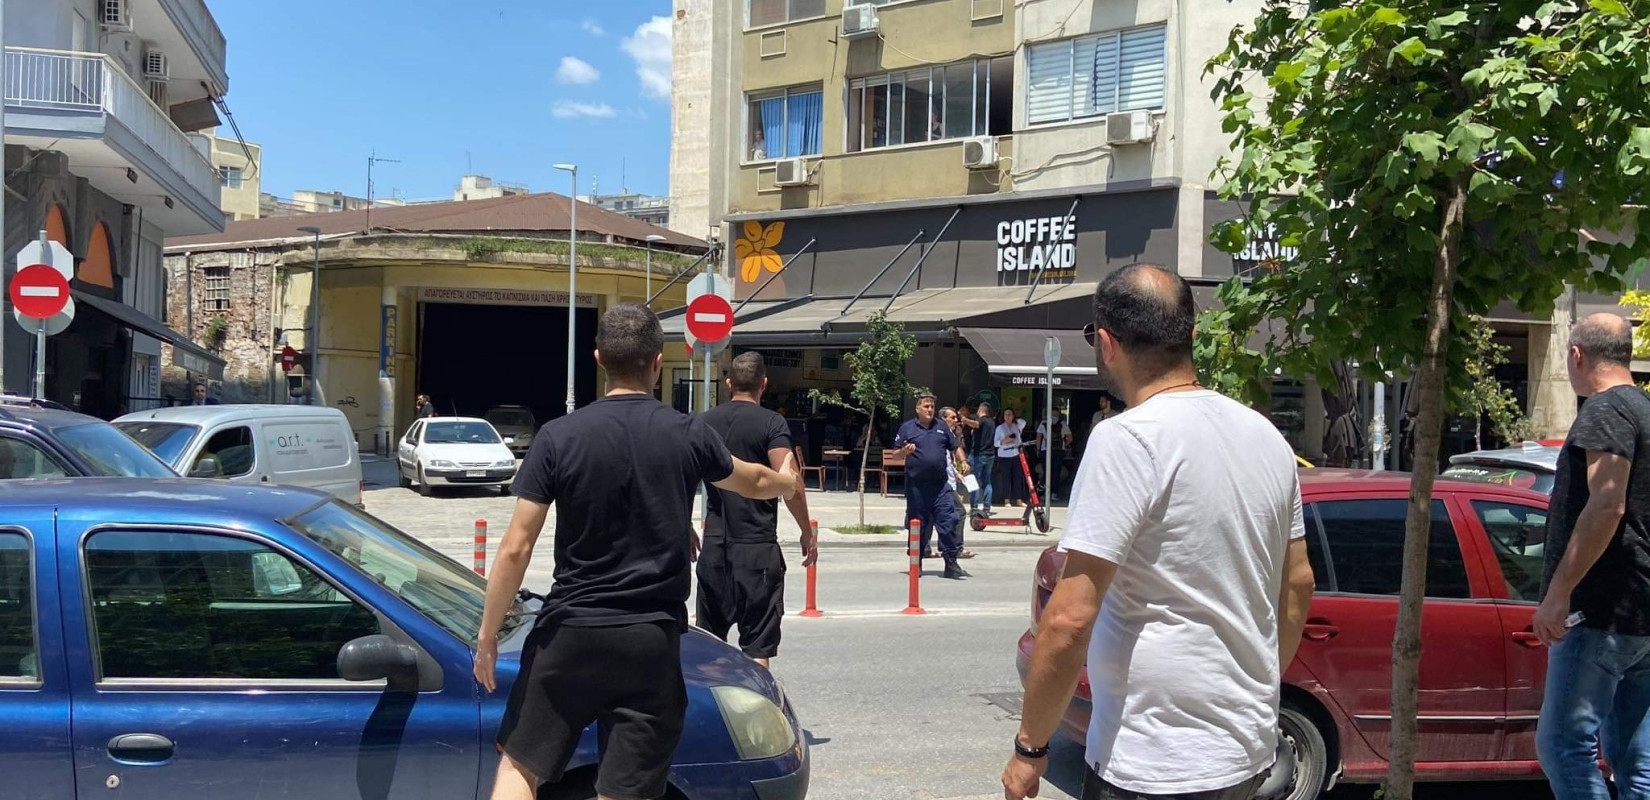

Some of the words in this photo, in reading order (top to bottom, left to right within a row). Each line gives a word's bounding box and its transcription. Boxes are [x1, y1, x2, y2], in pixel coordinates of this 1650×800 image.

[997, 215, 1076, 245] COFFEE
[996, 243, 1076, 272] ISLAND
[424, 288, 465, 299] ΑΠΑΓΟΡΕΥΕΤΑΙ
[493, 291, 501, 300] ΤΟ
[502, 291, 530, 302] ΚΑΠΝΙΣΜΑ
[531, 292, 540, 302] ΚΑΙ
[385, 307, 396, 376] PARKING
[1012, 376, 1036, 385] COFFEE
[1038, 377, 1062, 385] ISLND
